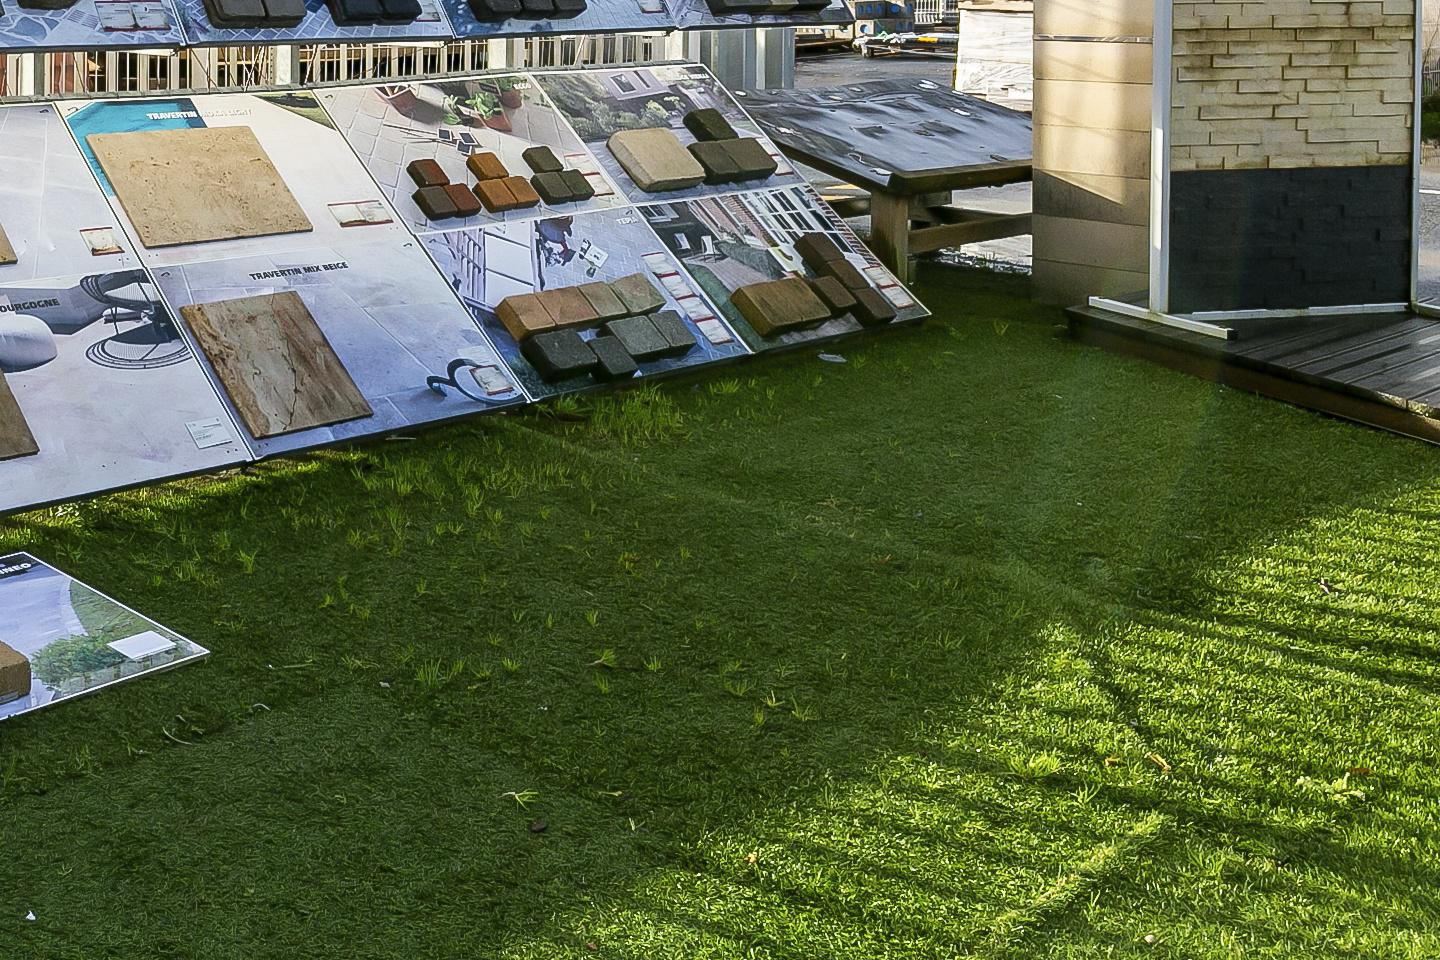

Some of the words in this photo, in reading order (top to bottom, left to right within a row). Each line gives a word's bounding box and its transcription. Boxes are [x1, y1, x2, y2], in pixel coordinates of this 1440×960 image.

[146, 111, 198, 120] TRAVERTIN
[249, 267, 302, 280] TRAVERTIN
[303, 265, 322, 274] MIX
[322, 261, 349, 271] BEIGE
